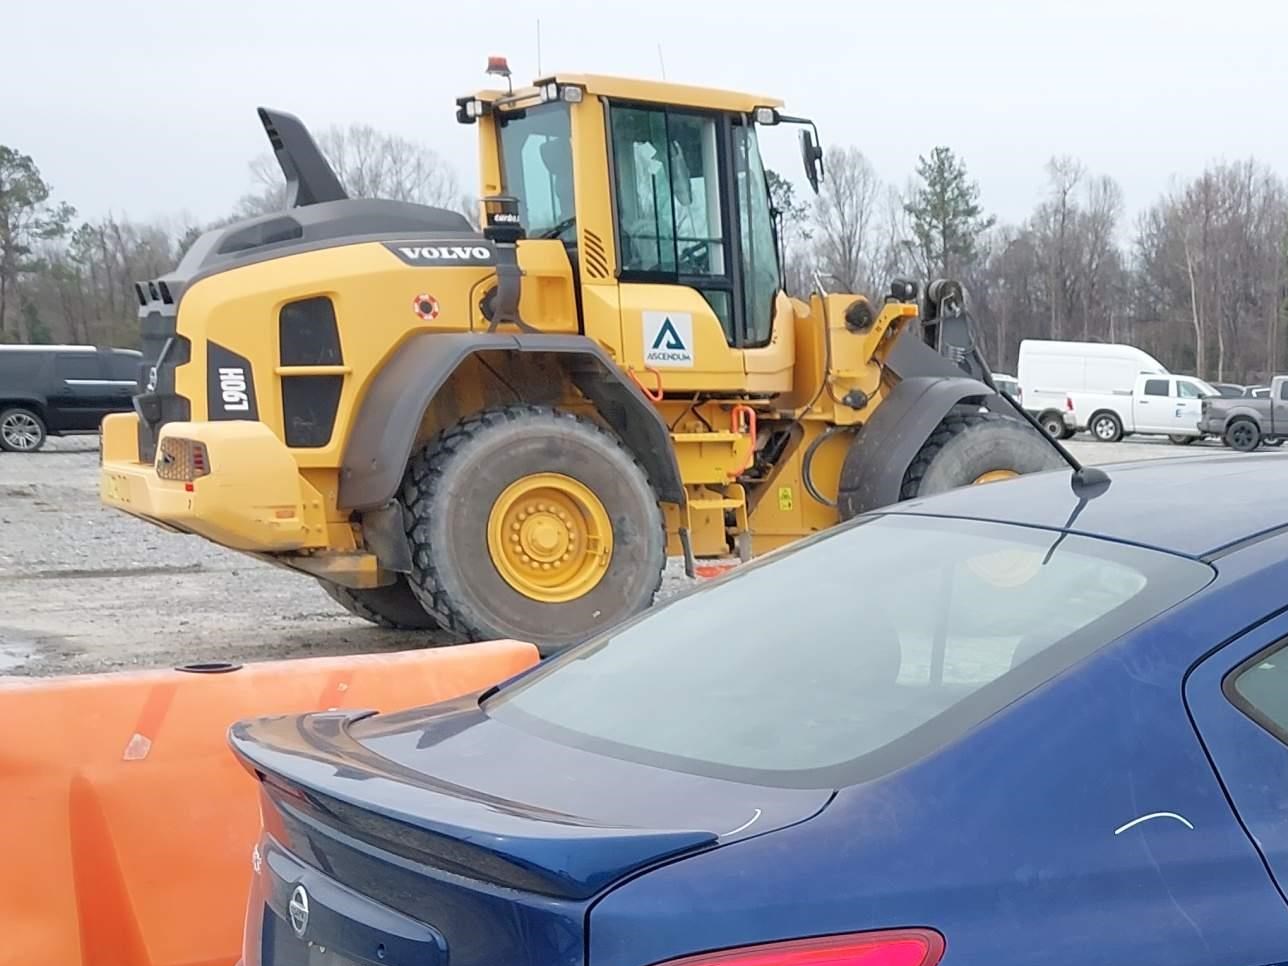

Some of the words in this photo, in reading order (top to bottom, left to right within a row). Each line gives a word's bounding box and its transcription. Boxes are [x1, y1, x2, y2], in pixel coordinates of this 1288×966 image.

[399, 246, 491, 260] VOLVO
[646, 352, 692, 361] ASCENDUM
[218, 367, 249, 411] L90H
